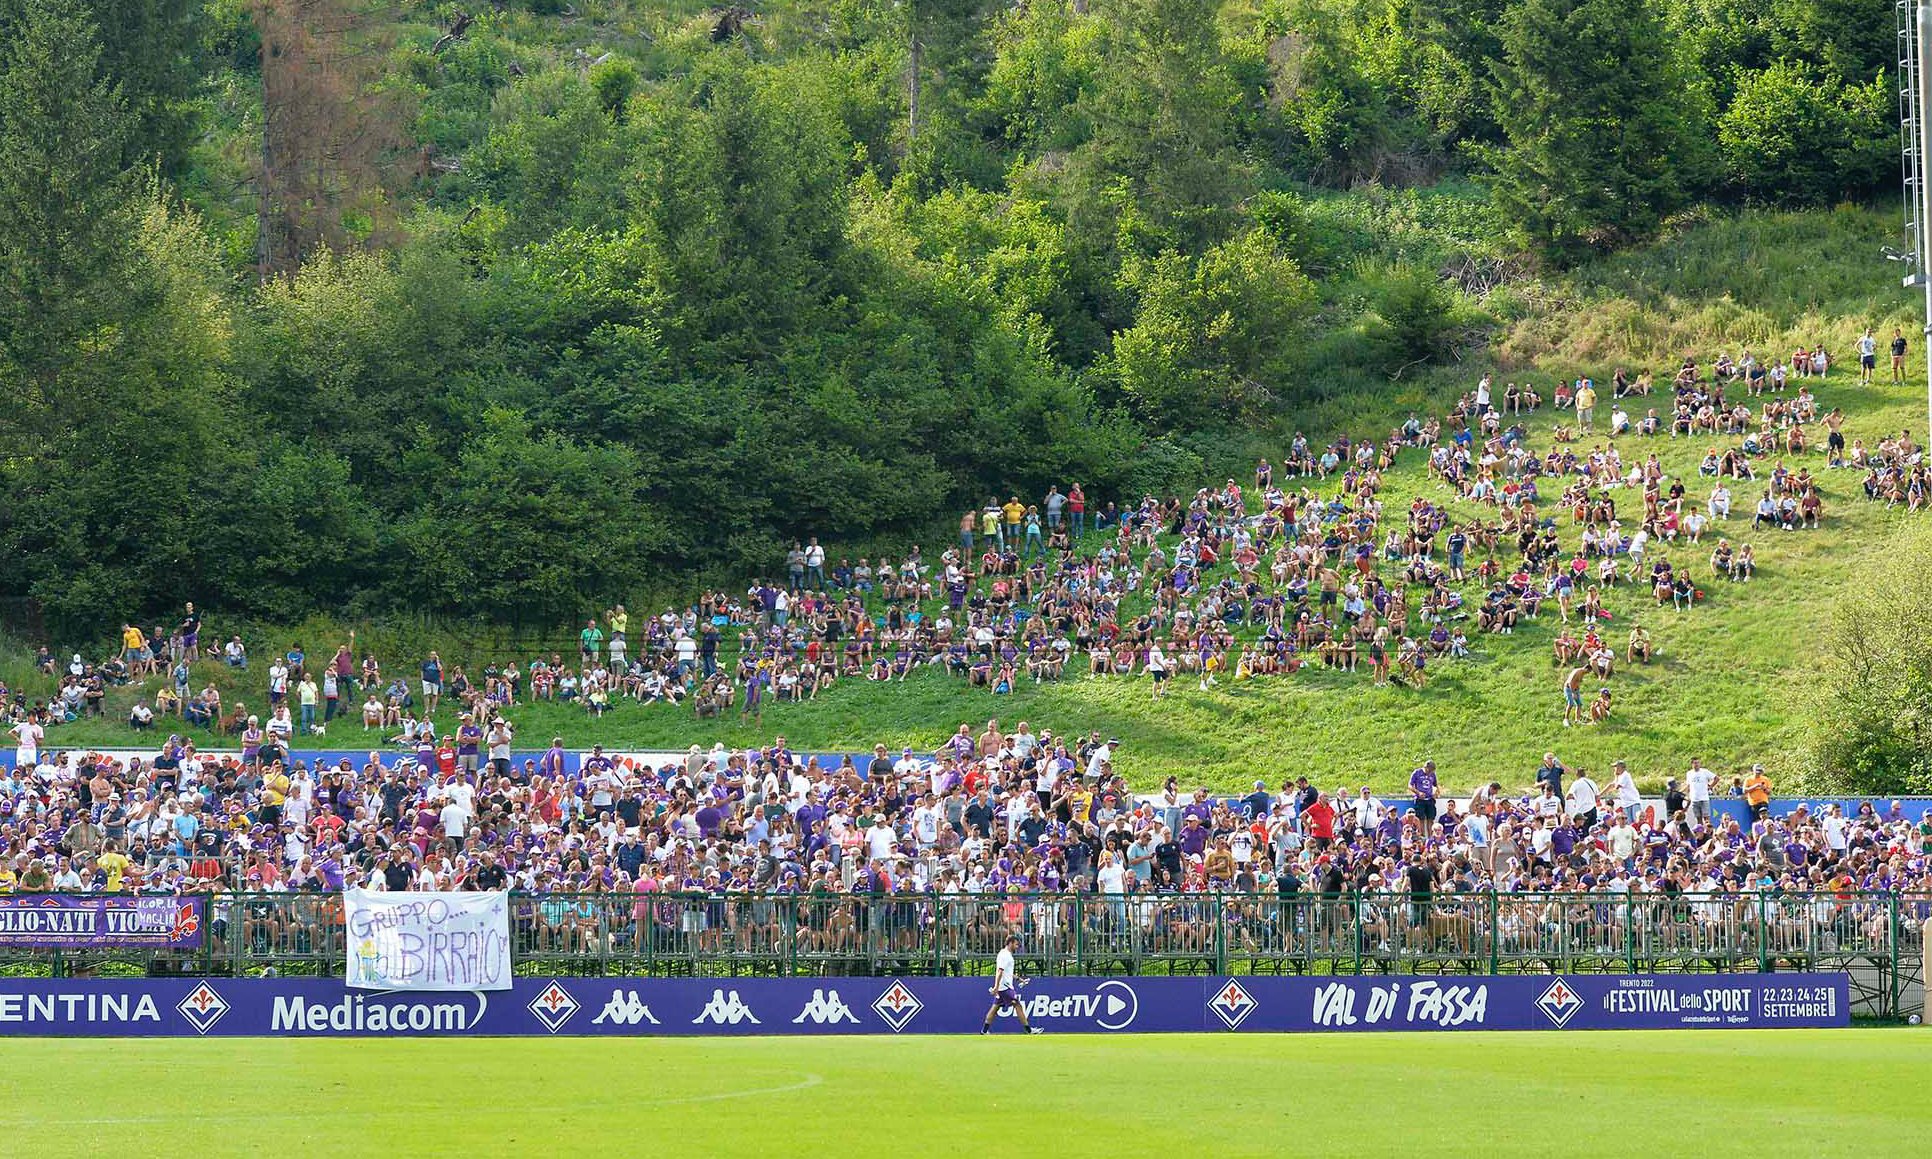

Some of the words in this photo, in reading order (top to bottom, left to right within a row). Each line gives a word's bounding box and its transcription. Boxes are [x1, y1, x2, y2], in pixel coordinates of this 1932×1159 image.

[1619, 979, 1640, 987] TRENTO
[1640, 979, 1654, 987] 2022
[0, 994, 161, 1022] ENTINA
[271, 994, 466, 1031] Mediacom
[1312, 982, 1358, 1026] VAL
[1406, 980, 1488, 1027] FASSA
[1610, 989, 1680, 1013] FESTIVAL
[1680, 993, 1702, 1009] dello
[1703, 988, 1751, 1012] SPORT
[1763, 1003, 1828, 1018] SETTEMBRE
